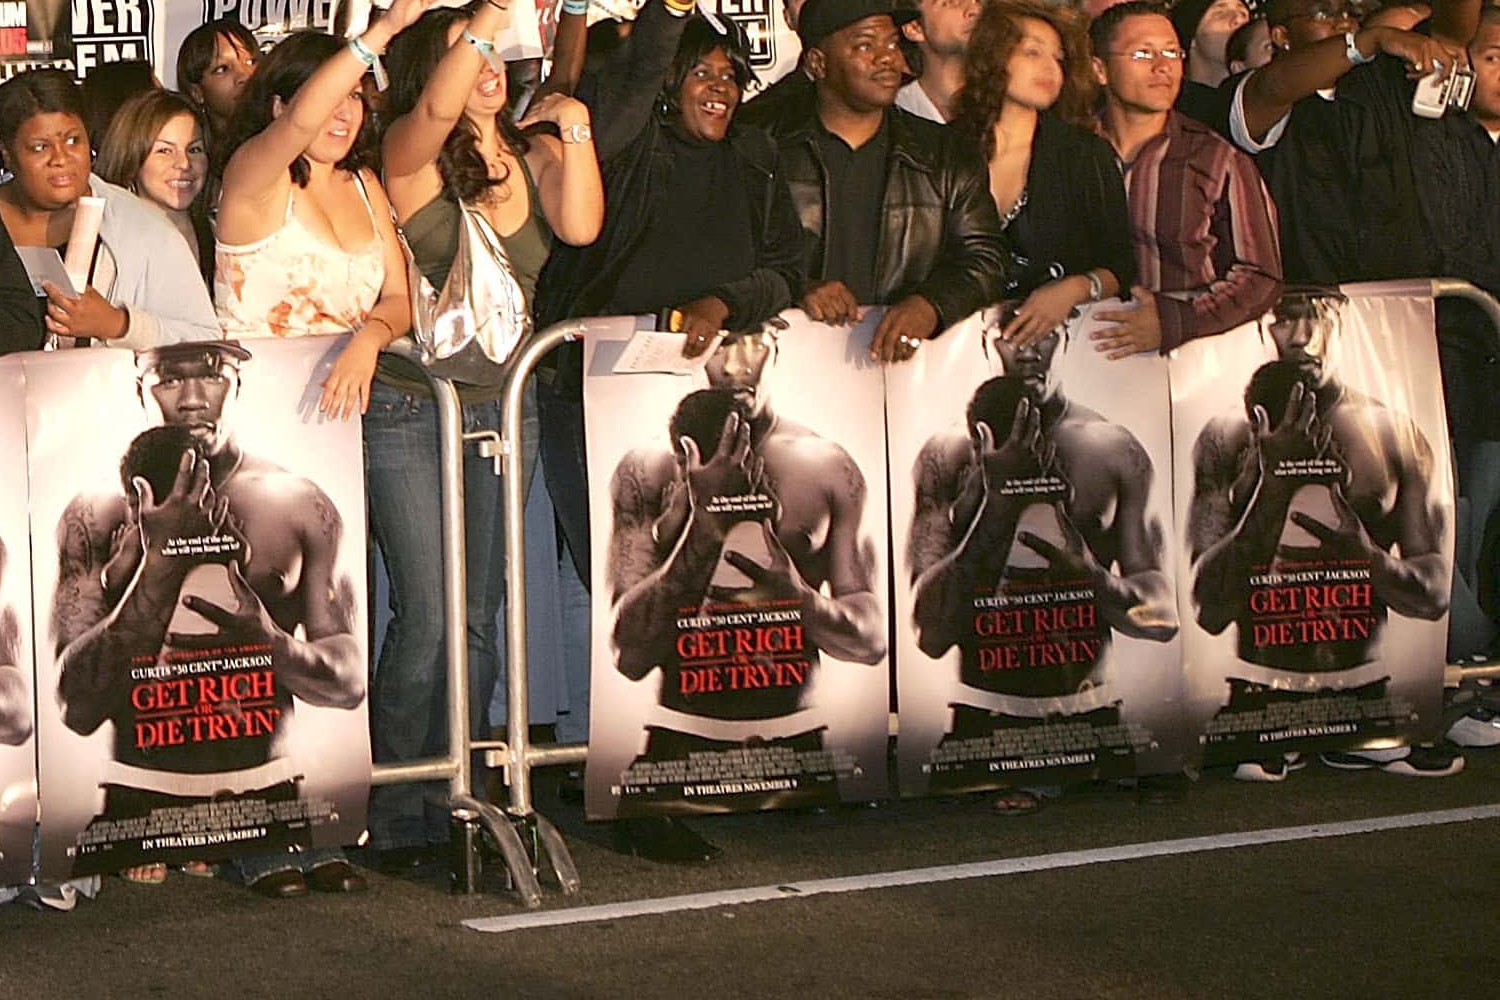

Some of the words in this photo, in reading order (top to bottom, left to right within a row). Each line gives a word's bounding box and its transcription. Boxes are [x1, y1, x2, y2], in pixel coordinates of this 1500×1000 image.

[1251, 588, 1300, 613] GET
[1304, 584, 1372, 608] RICH
[975, 610, 1028, 636] GET
[1033, 605, 1096, 631] RICH
[677, 630, 731, 658] GET
[735, 626, 804, 653] RICH
[1253, 624, 1294, 648] DIE
[979, 647, 1021, 670] DIE
[132, 679, 193, 711] GET
[197, 672, 275, 702] RICH
[680, 669, 723, 694] DIE
[135, 720, 185, 749] DIE
[187, 709, 281, 741] TRYIN'
